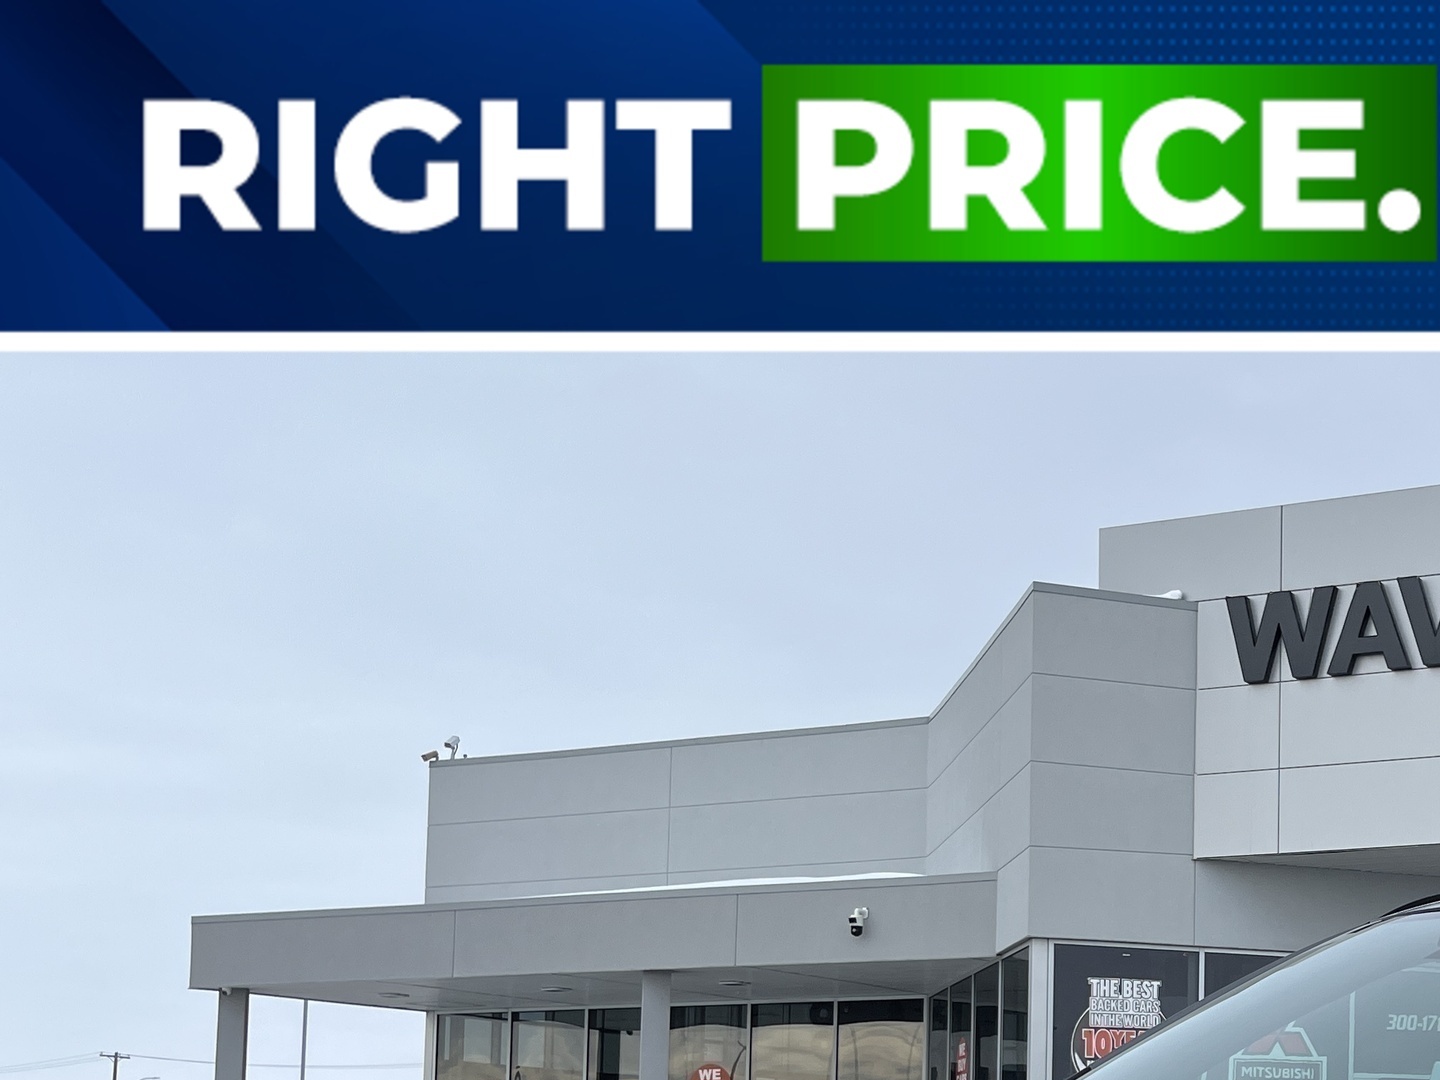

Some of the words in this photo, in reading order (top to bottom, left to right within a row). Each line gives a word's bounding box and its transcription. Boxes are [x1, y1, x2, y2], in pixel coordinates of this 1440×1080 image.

[1087, 977, 1119, 999] THE
[1122, 979, 1162, 1000] BEST
[1090, 998, 1132, 1012] BACKED
[1133, 999, 1160, 1013] CARS
[1102, 1012, 1122, 1027] THE
[1123, 1013, 1160, 1028] WORLD
[698, 1068, 721, 1080] WE
[1240, 1066, 1315, 1080] MITSUBISHI
